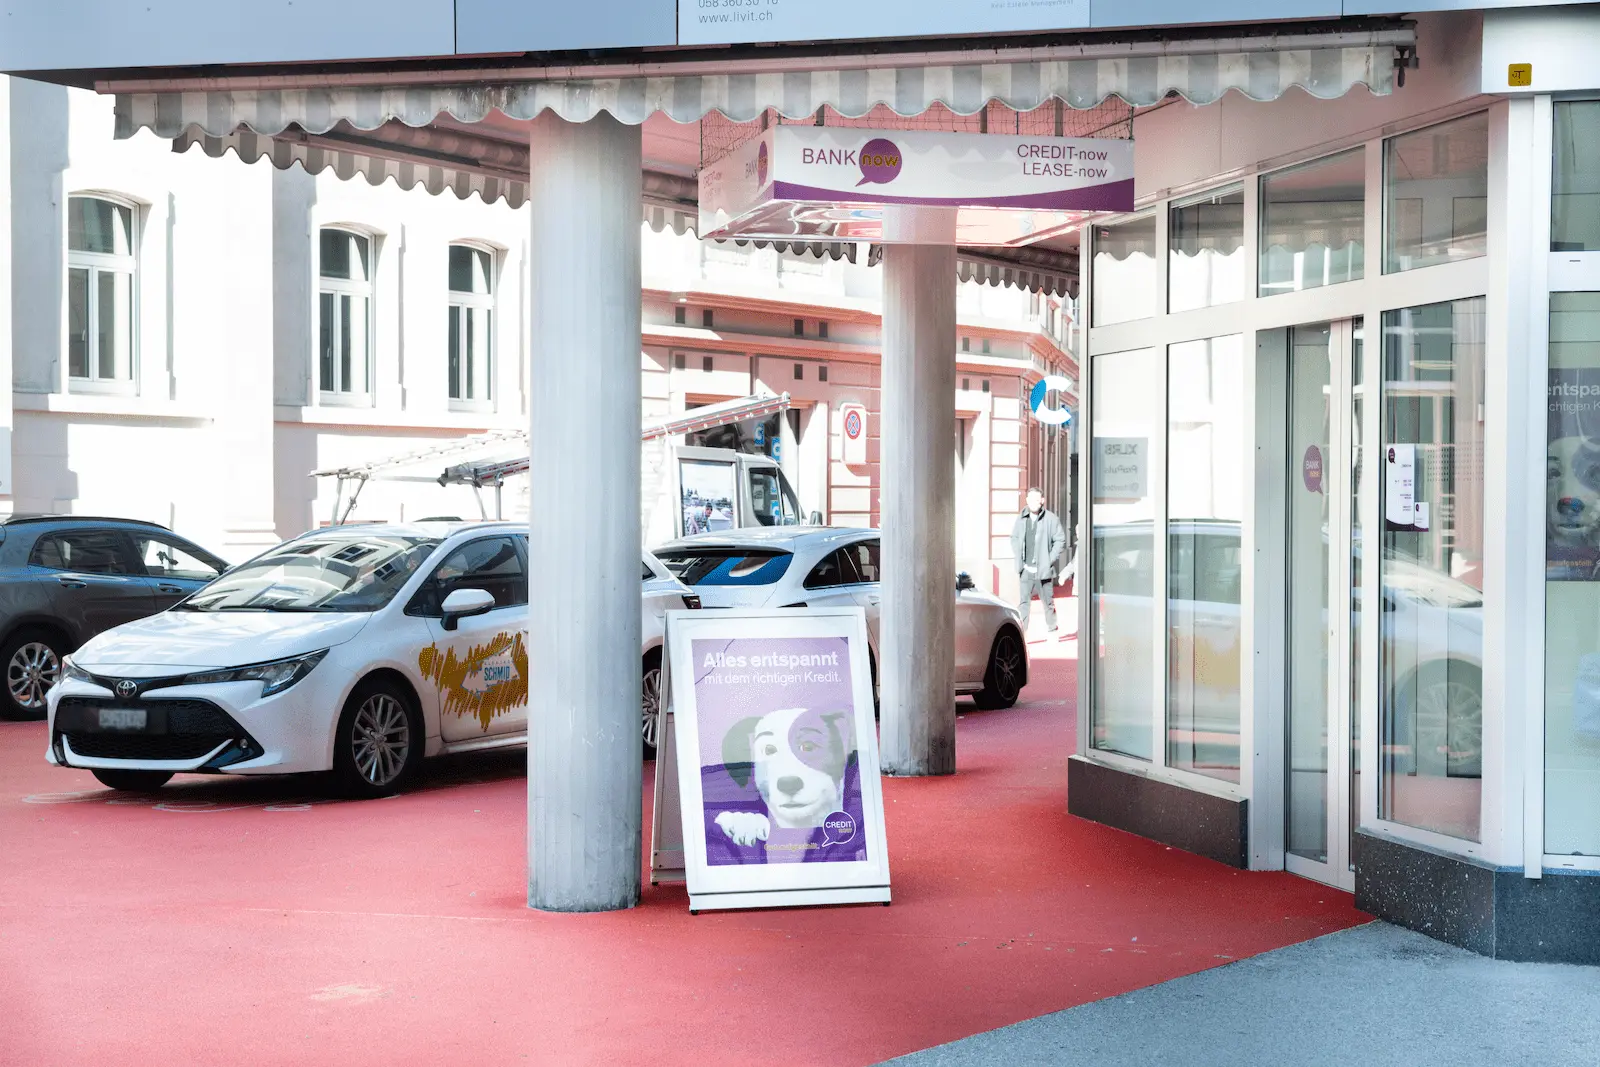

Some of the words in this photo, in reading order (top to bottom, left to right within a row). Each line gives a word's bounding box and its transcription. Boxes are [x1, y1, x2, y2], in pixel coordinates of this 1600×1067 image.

[698, 10, 773, 24] www.livit.ch
[803, 148, 856, 165] BANK
[862, 153, 899, 167] now
[1017, 144, 1108, 161] CREDIT-now
[1023, 161, 1108, 178] LEASE-now
[703, 652, 747, 668] Alles
[750, 651, 839, 670] entspannt
[484, 666, 510, 681] SCHMID
[704, 674, 722, 684] mit
[724, 671, 749, 684] dem
[752, 672, 802, 686] richtigen
[804, 670, 842, 683] Kredit.
[825, 820, 853, 829] CREDIT
